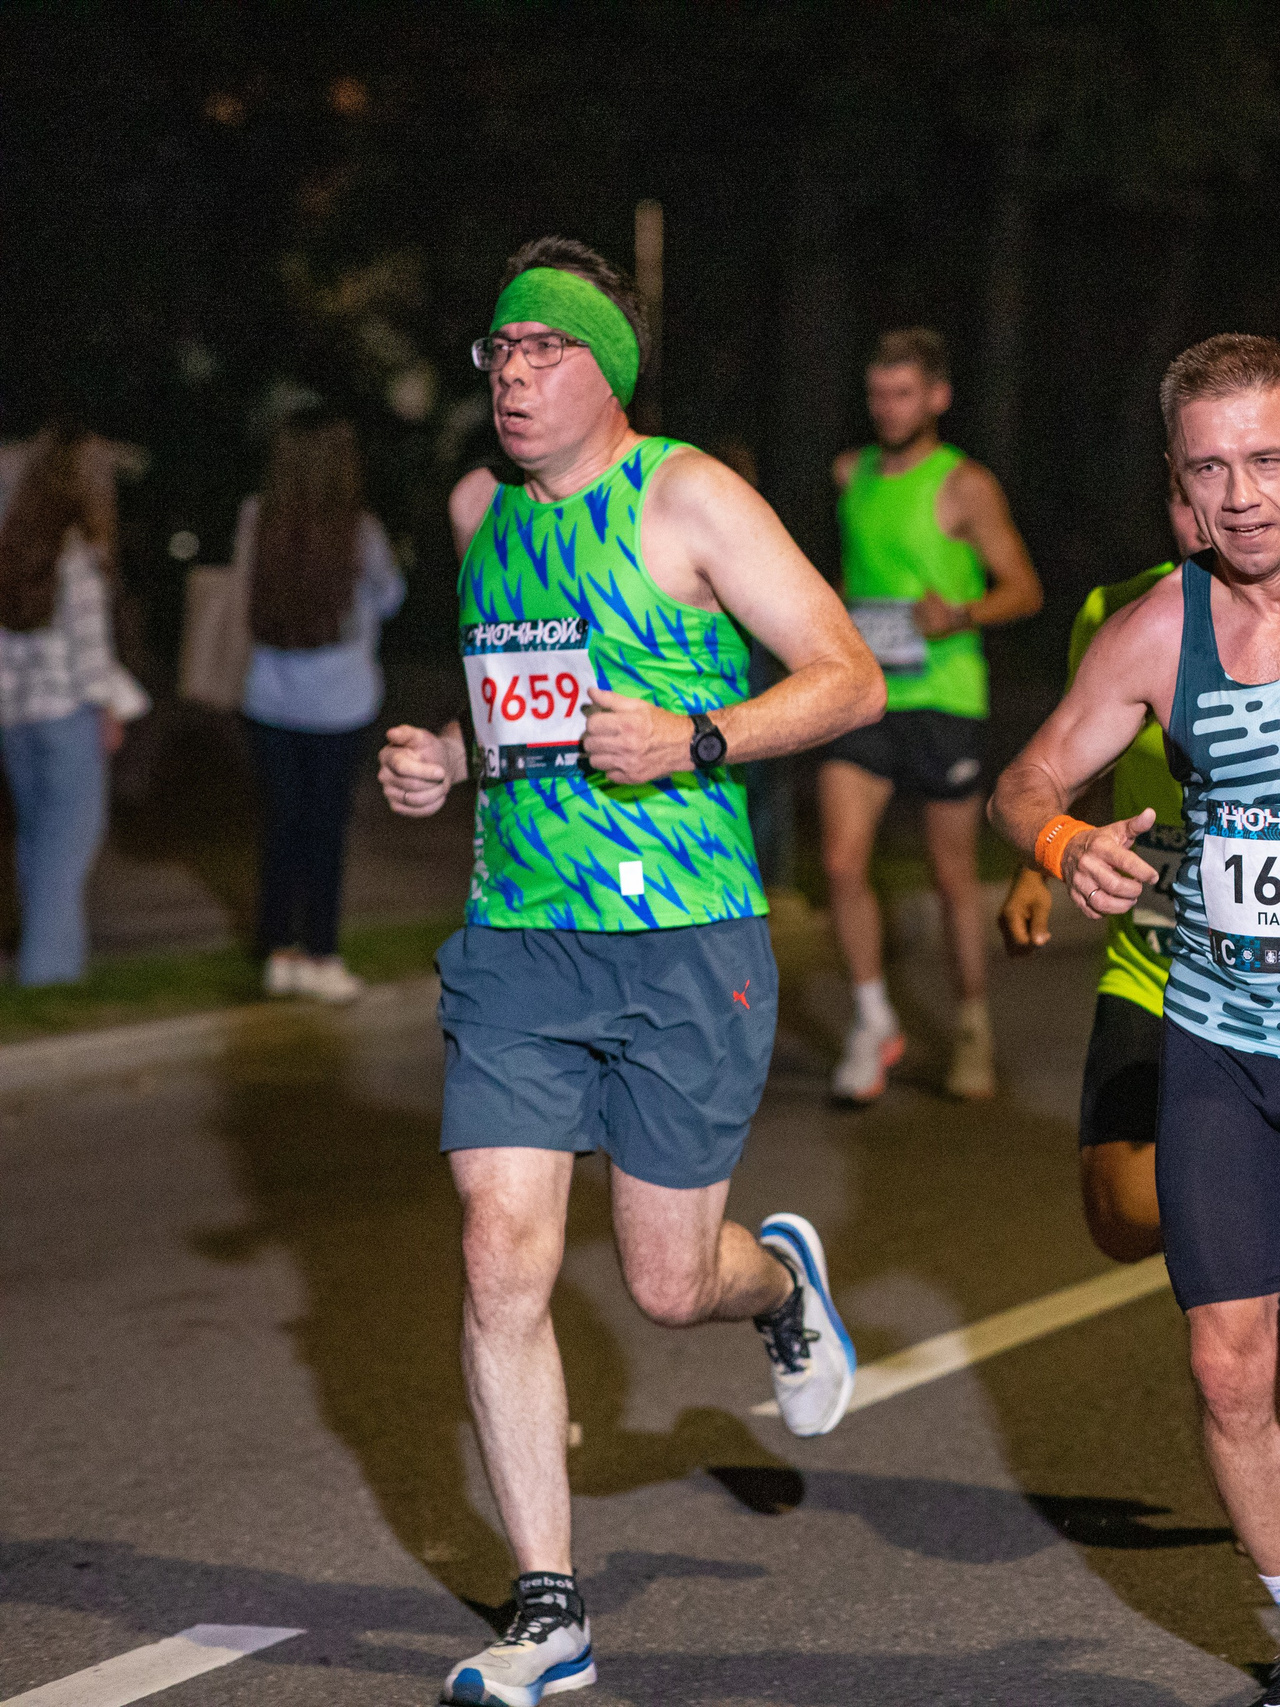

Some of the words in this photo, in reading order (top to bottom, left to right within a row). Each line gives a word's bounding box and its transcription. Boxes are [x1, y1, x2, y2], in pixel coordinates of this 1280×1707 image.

[473, 617, 581, 647] НОЧНОЙ
[481, 672, 580, 724] 9659
[1221, 939, 1236, 966] C
